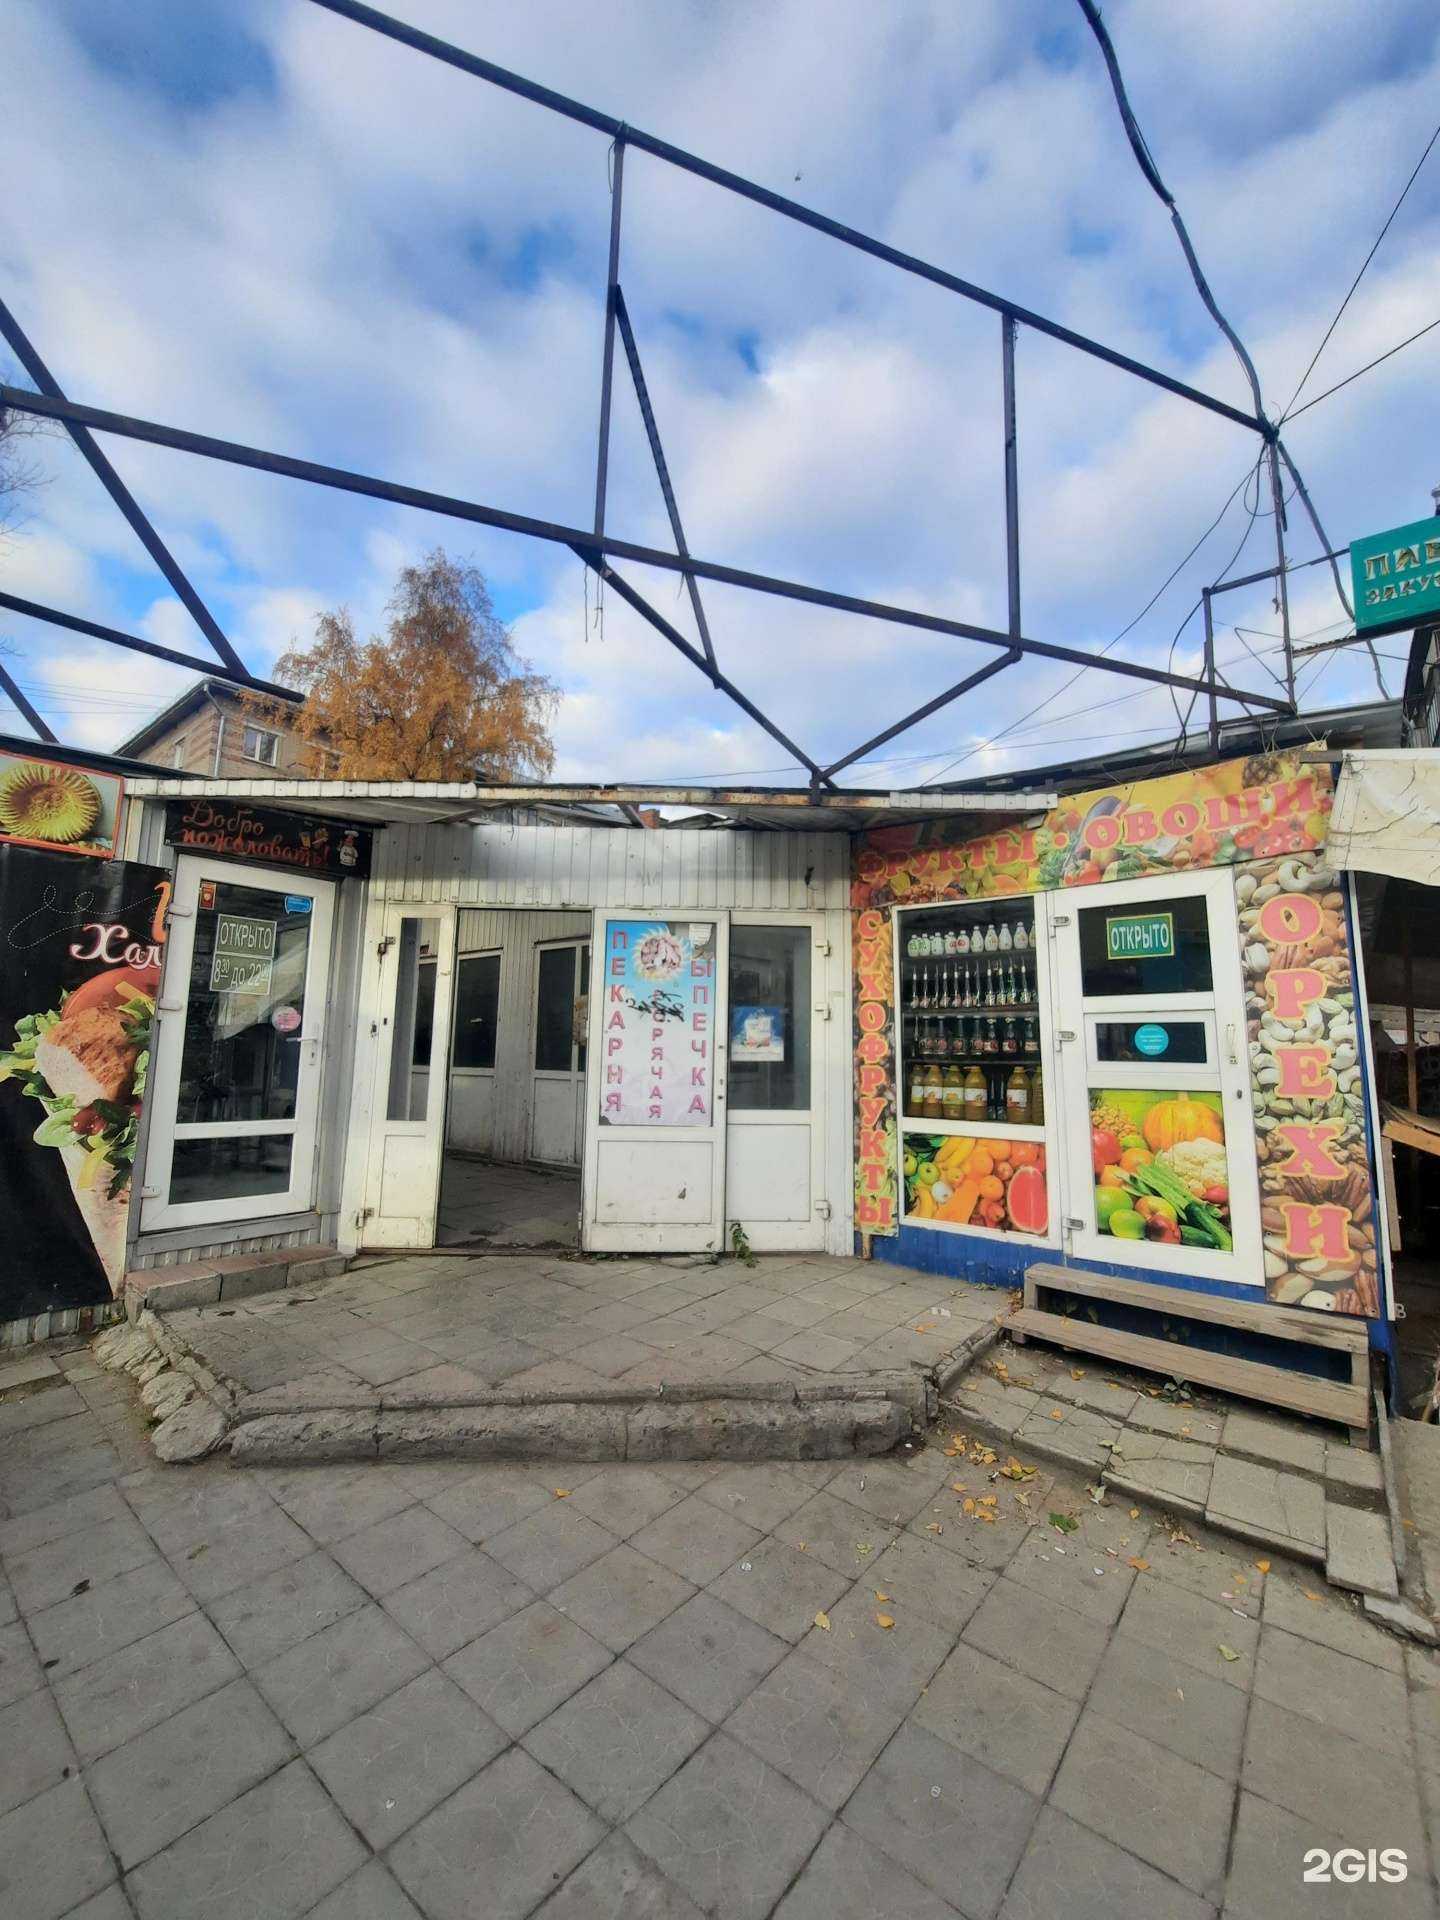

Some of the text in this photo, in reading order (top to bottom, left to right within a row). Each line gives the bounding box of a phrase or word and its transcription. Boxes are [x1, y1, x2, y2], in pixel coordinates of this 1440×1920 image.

[183, 801, 264, 835] Добро
[1085, 777, 1318, 849] ОВОЩИ
[220, 922, 272, 949] ОТКРЫТО
[1111, 921, 1169, 951] ОТКРЫТО
[605, 929, 628, 1112] ПЕКАРНЯ
[688, 959, 712, 1113] ЫПЕЧКА
[858, 909, 893, 1226] СУХОФРУКТЫ
[1260, 895, 1353, 1260] ОРЕХИ
